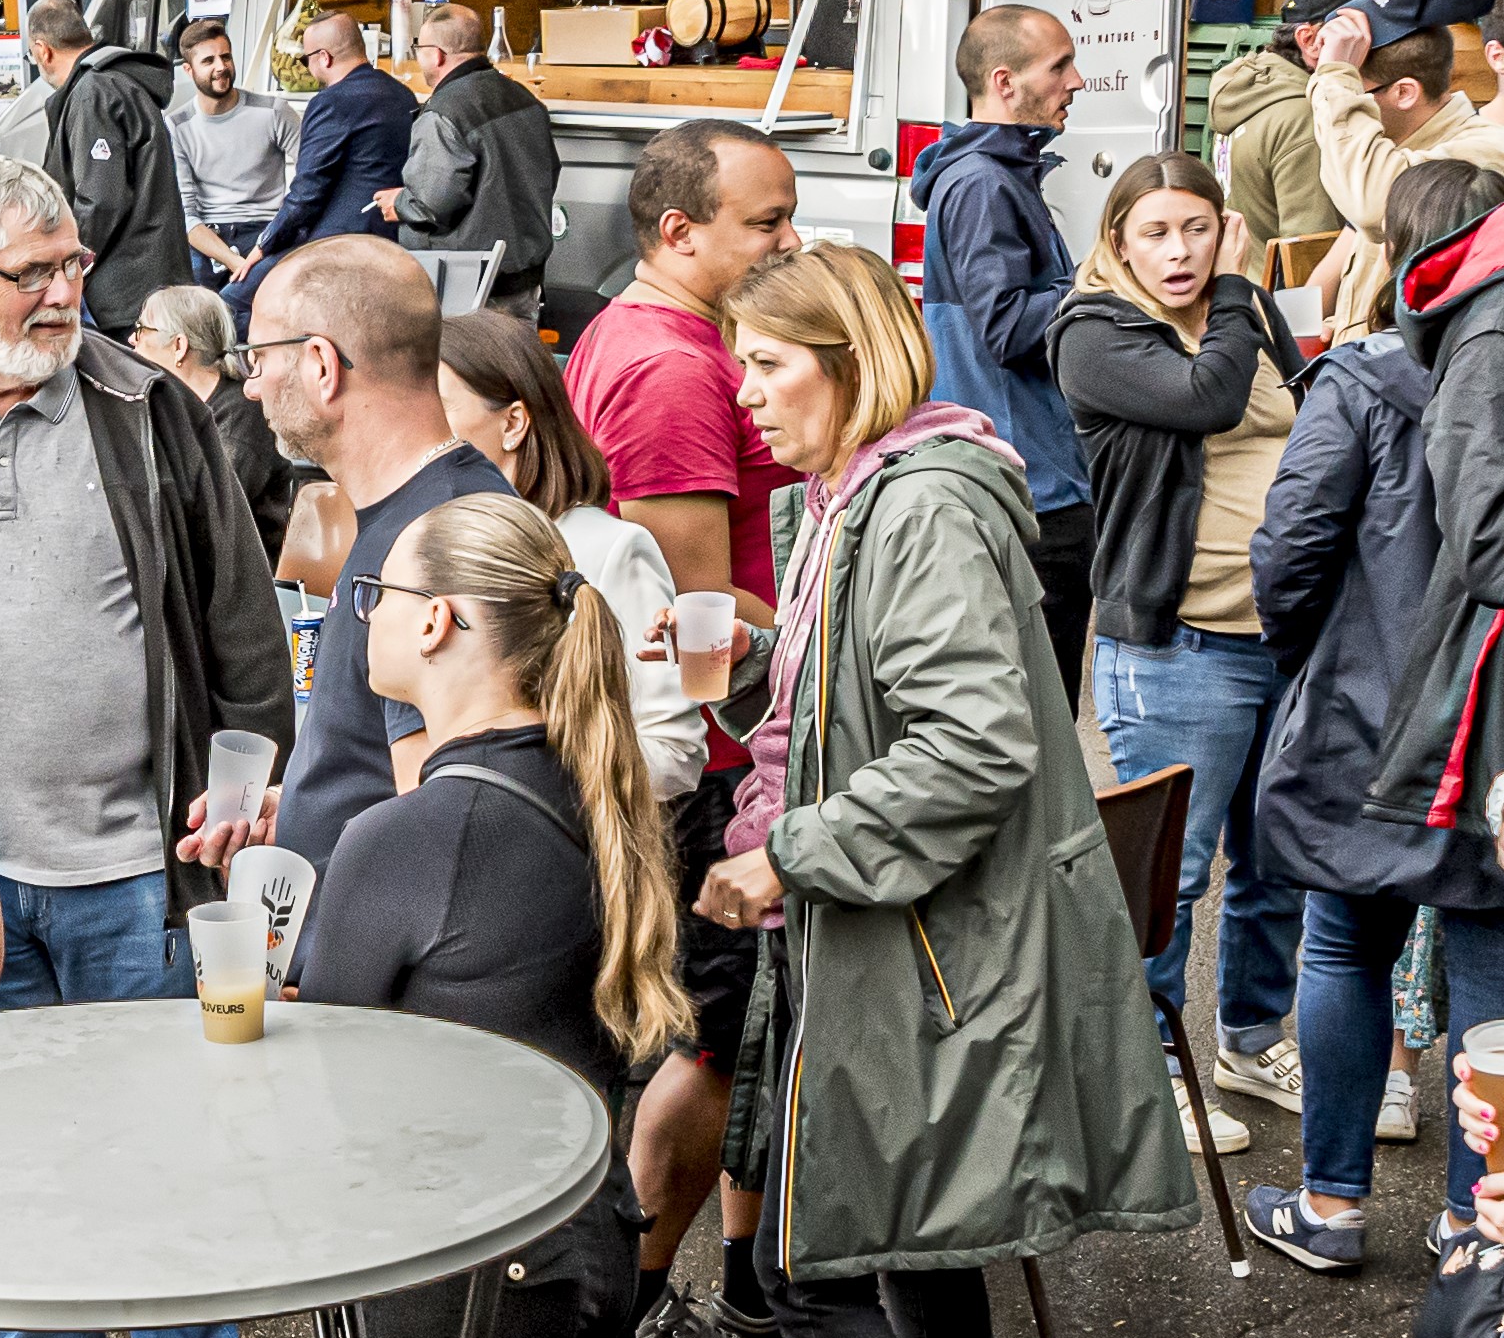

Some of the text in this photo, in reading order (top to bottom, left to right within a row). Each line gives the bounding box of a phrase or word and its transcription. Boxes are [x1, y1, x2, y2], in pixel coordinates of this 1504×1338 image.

[1072, 34, 1090, 45] INS
[1097, 31, 1135, 44] NATURE
[1083, 69, 1128, 93] ous.fr
